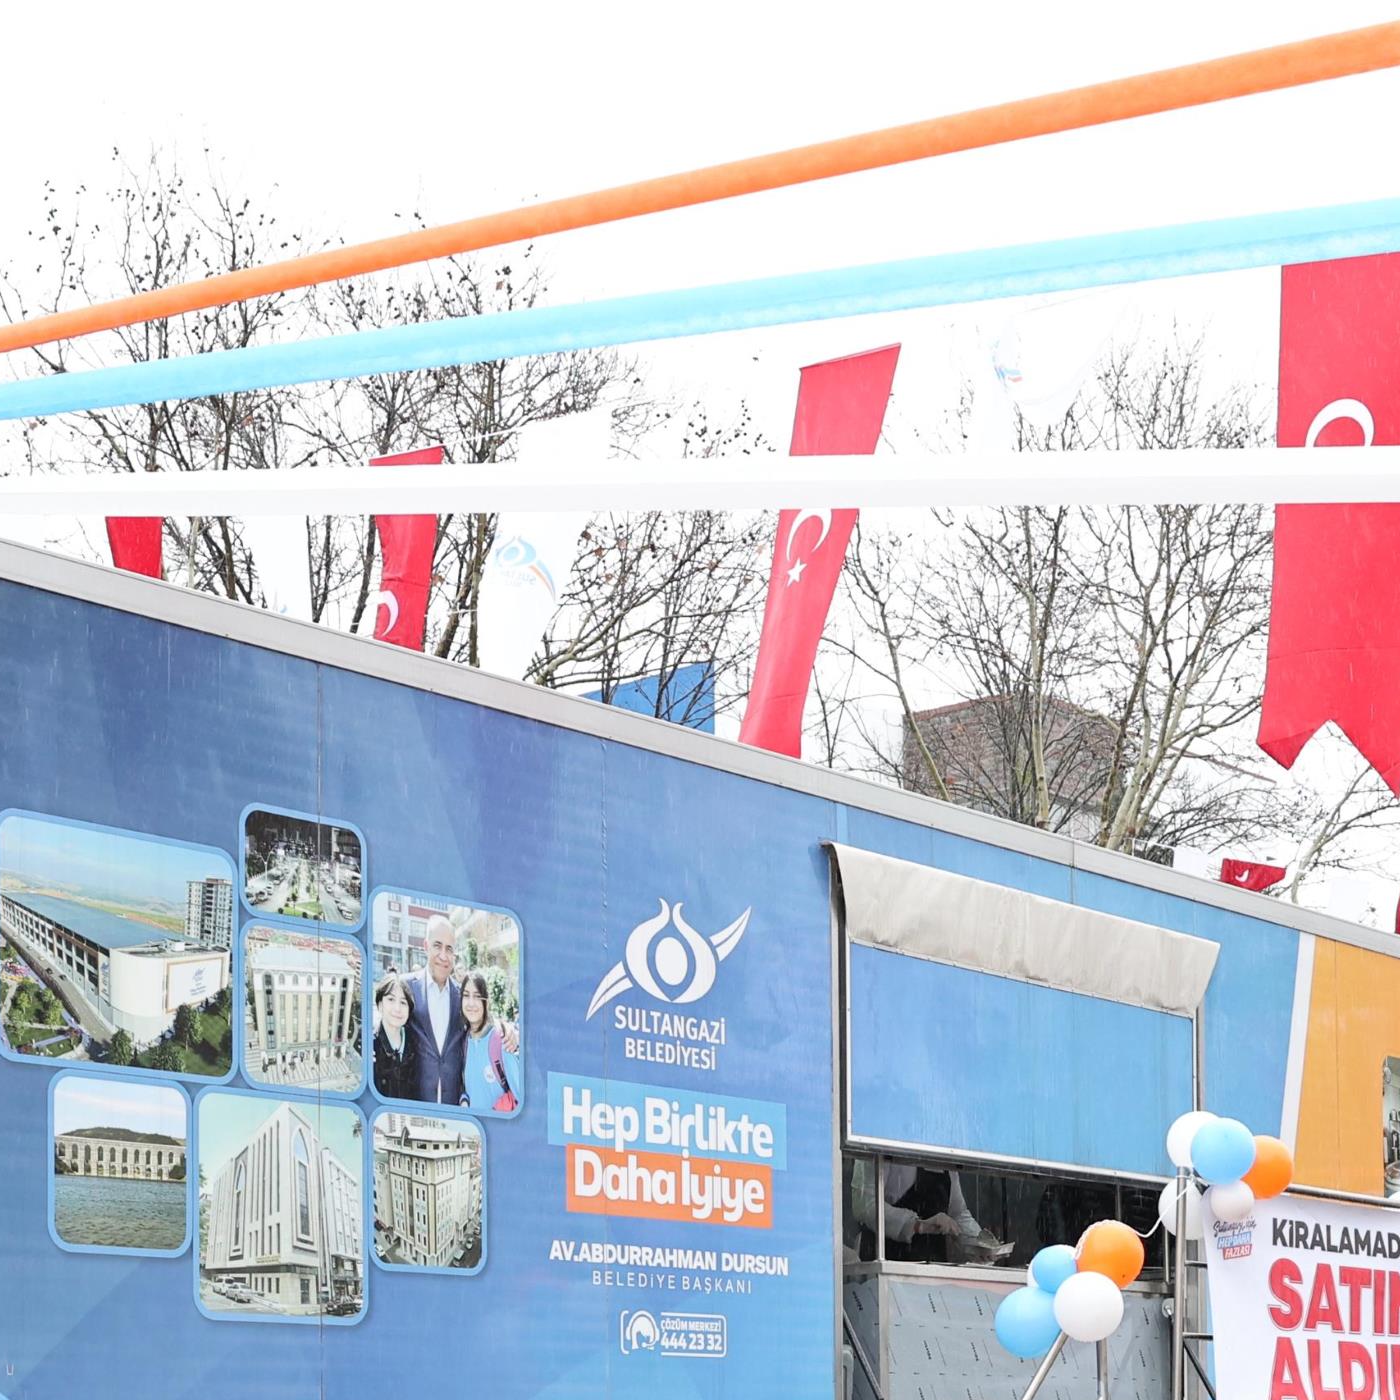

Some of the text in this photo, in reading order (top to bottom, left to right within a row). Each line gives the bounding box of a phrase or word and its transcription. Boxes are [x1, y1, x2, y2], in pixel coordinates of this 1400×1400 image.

[614, 1005, 725, 1045] SULTANGAZİ
[625, 1038, 716, 1070] BELEDİYESİ
[562, 1085, 773, 1157] Hep Birlikte
[574, 1148, 765, 1222] Daha İyiye
[549, 1239, 789, 1276] AV.ABDURRAHMAN DURSUN
[681, 1274, 752, 1295] BAŞKANI
[661, 1318, 721, 1332] ÇÖZÜM MERKEZİ
[661, 1332, 722, 1351] 444 23 32
